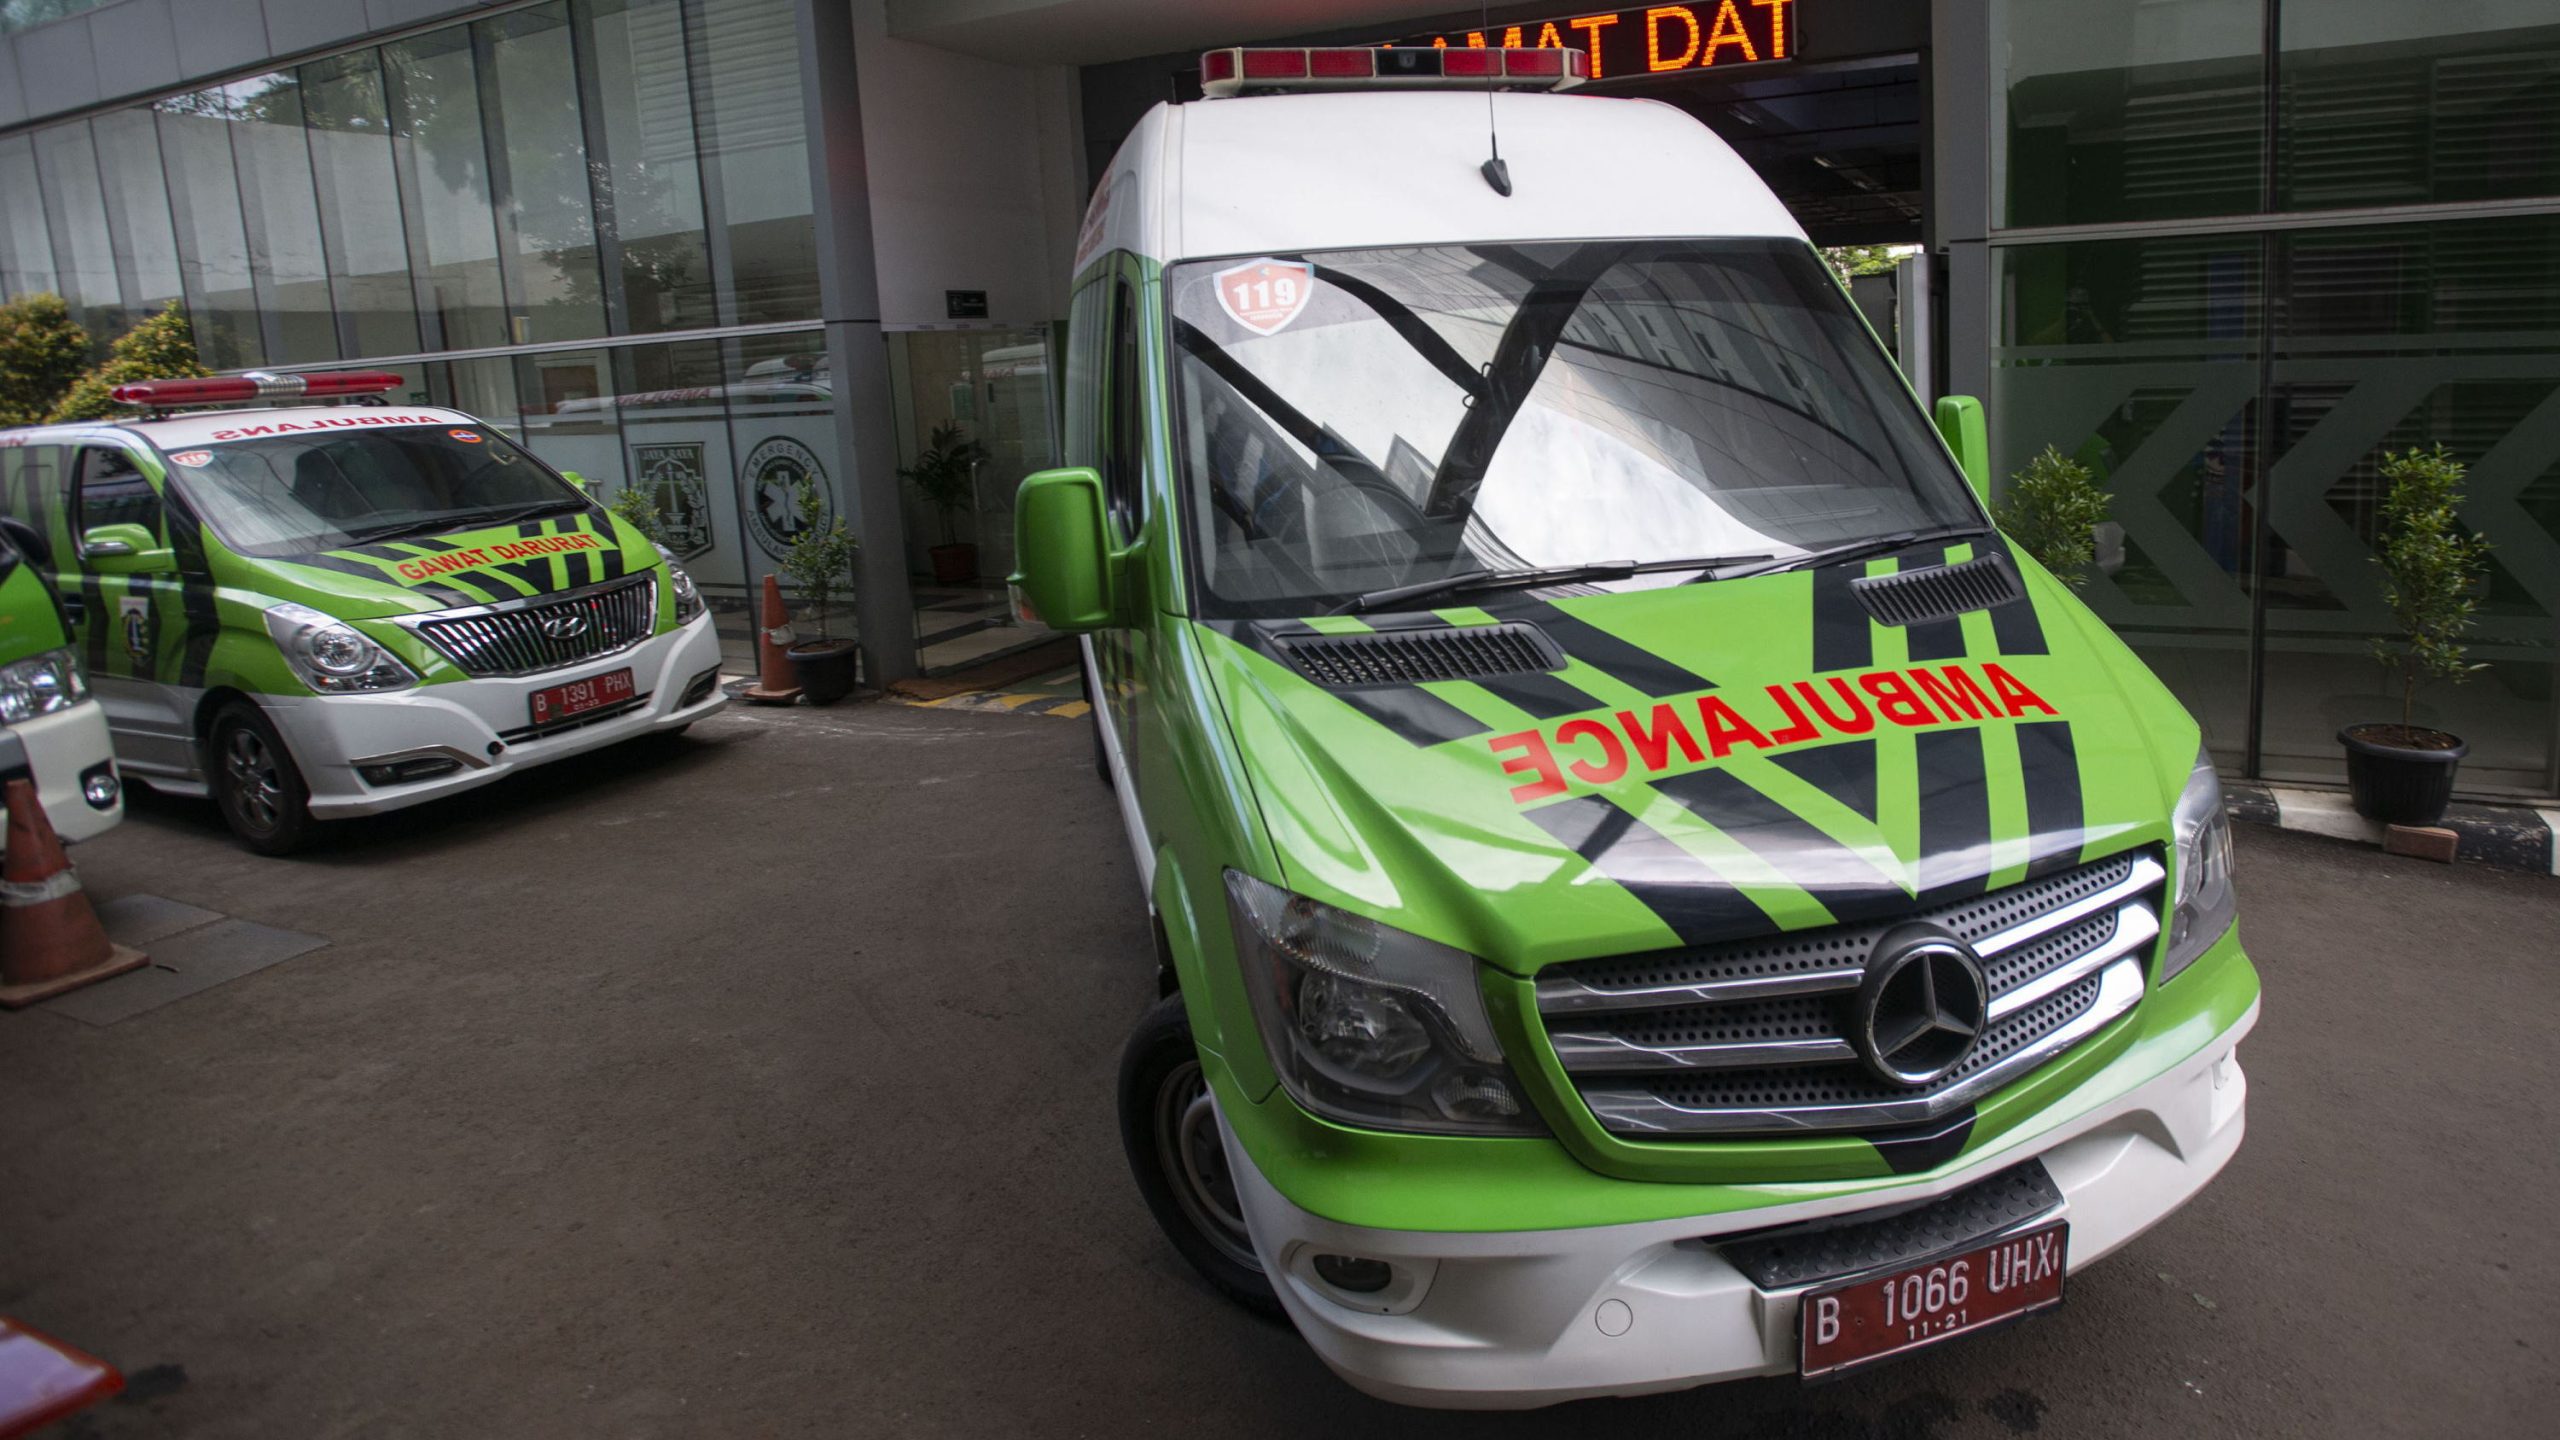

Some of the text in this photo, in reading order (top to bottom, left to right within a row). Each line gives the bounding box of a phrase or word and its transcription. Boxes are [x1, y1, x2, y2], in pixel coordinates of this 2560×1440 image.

[1647, 0, 1792, 72] DAT
[1233, 277, 1297, 311] 119
[747, 443, 819, 479] EMERGENCY
[397, 534, 601, 580] GAWAT DARURAT
[535, 671, 632, 712] B 1391 PHX
[1816, 1232, 2055, 1345] B 1066 UHX
